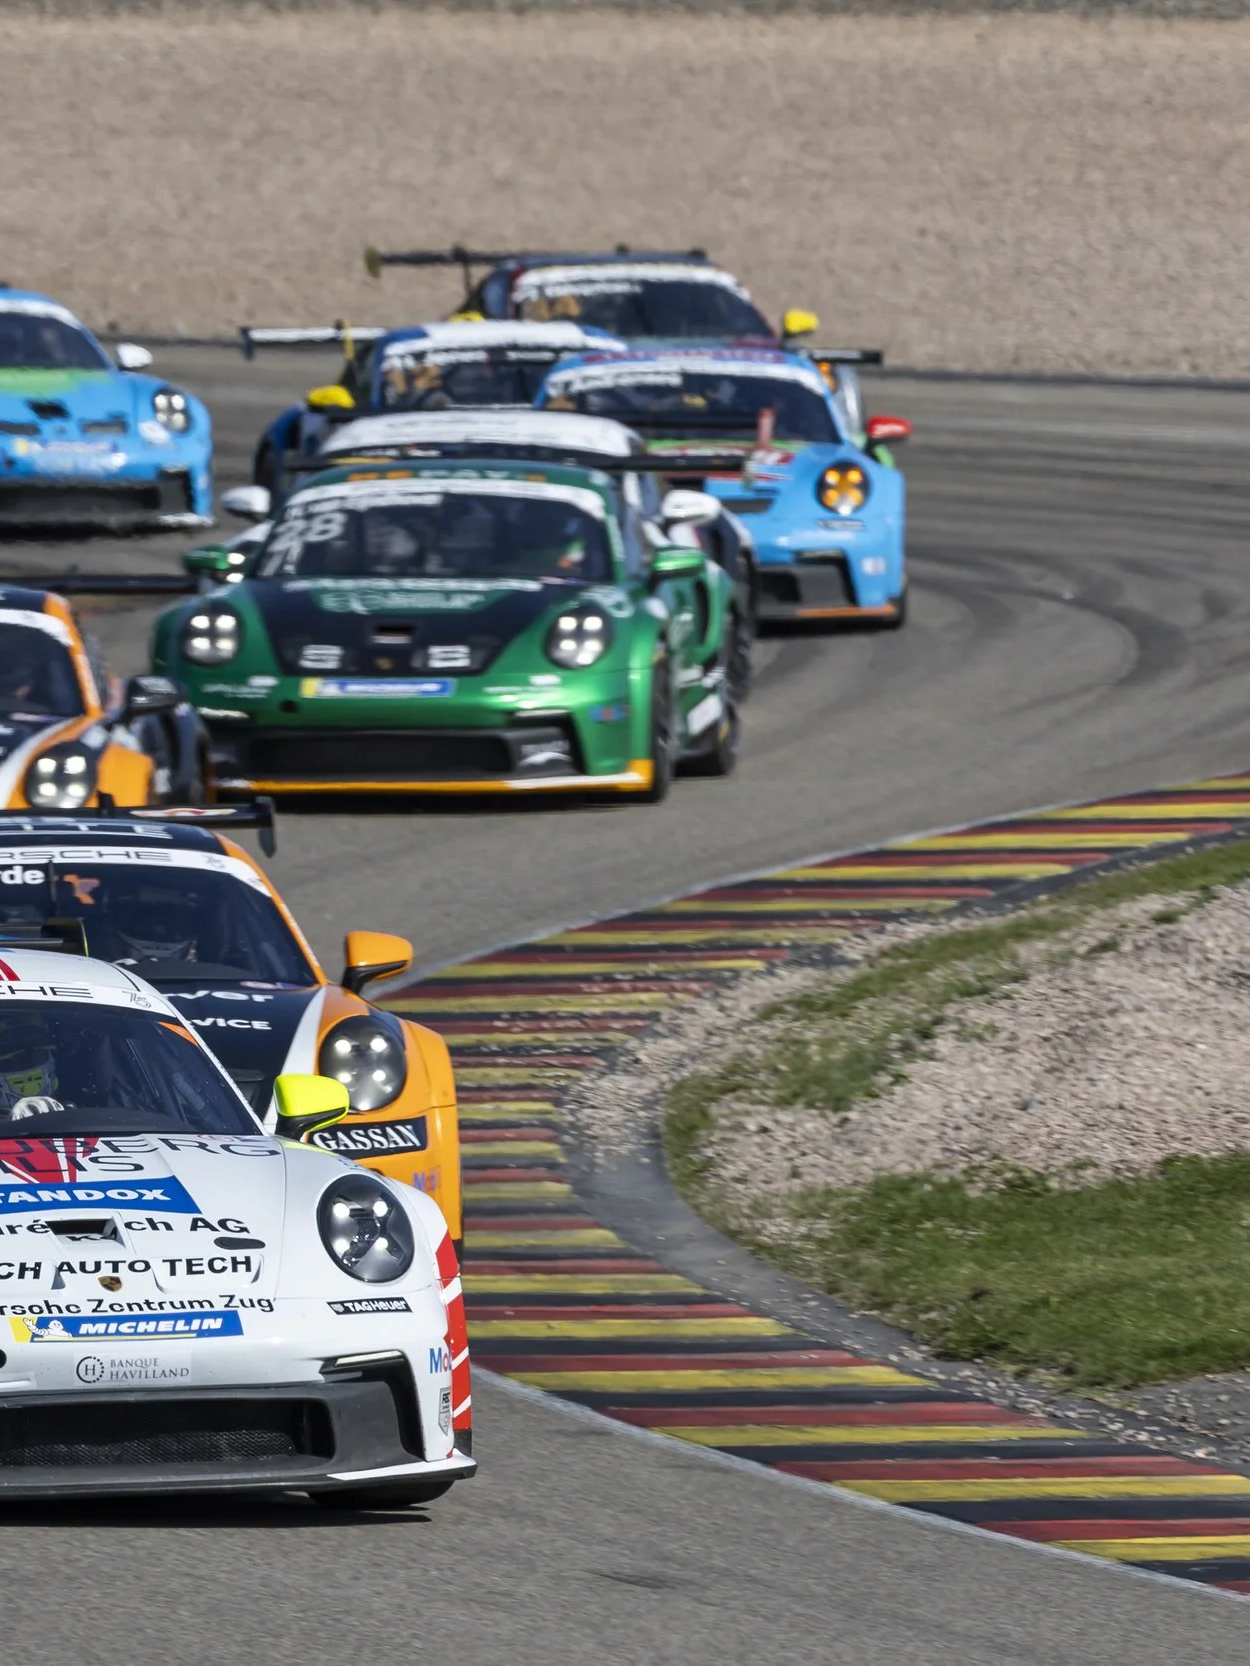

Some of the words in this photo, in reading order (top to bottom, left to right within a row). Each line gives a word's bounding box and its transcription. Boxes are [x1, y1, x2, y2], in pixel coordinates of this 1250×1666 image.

[312, 1125, 422, 1151] GASSAN
[189, 1216, 251, 1234] AG
[56, 1259, 152, 1275] AUTO
[162, 1255, 252, 1277] TECH
[218, 1294, 275, 1313] Zug
[79, 1318, 224, 1335] MICHELIN
[110, 1357, 160, 1370] BANQUE
[110, 1367, 190, 1380] HAVILLAND
